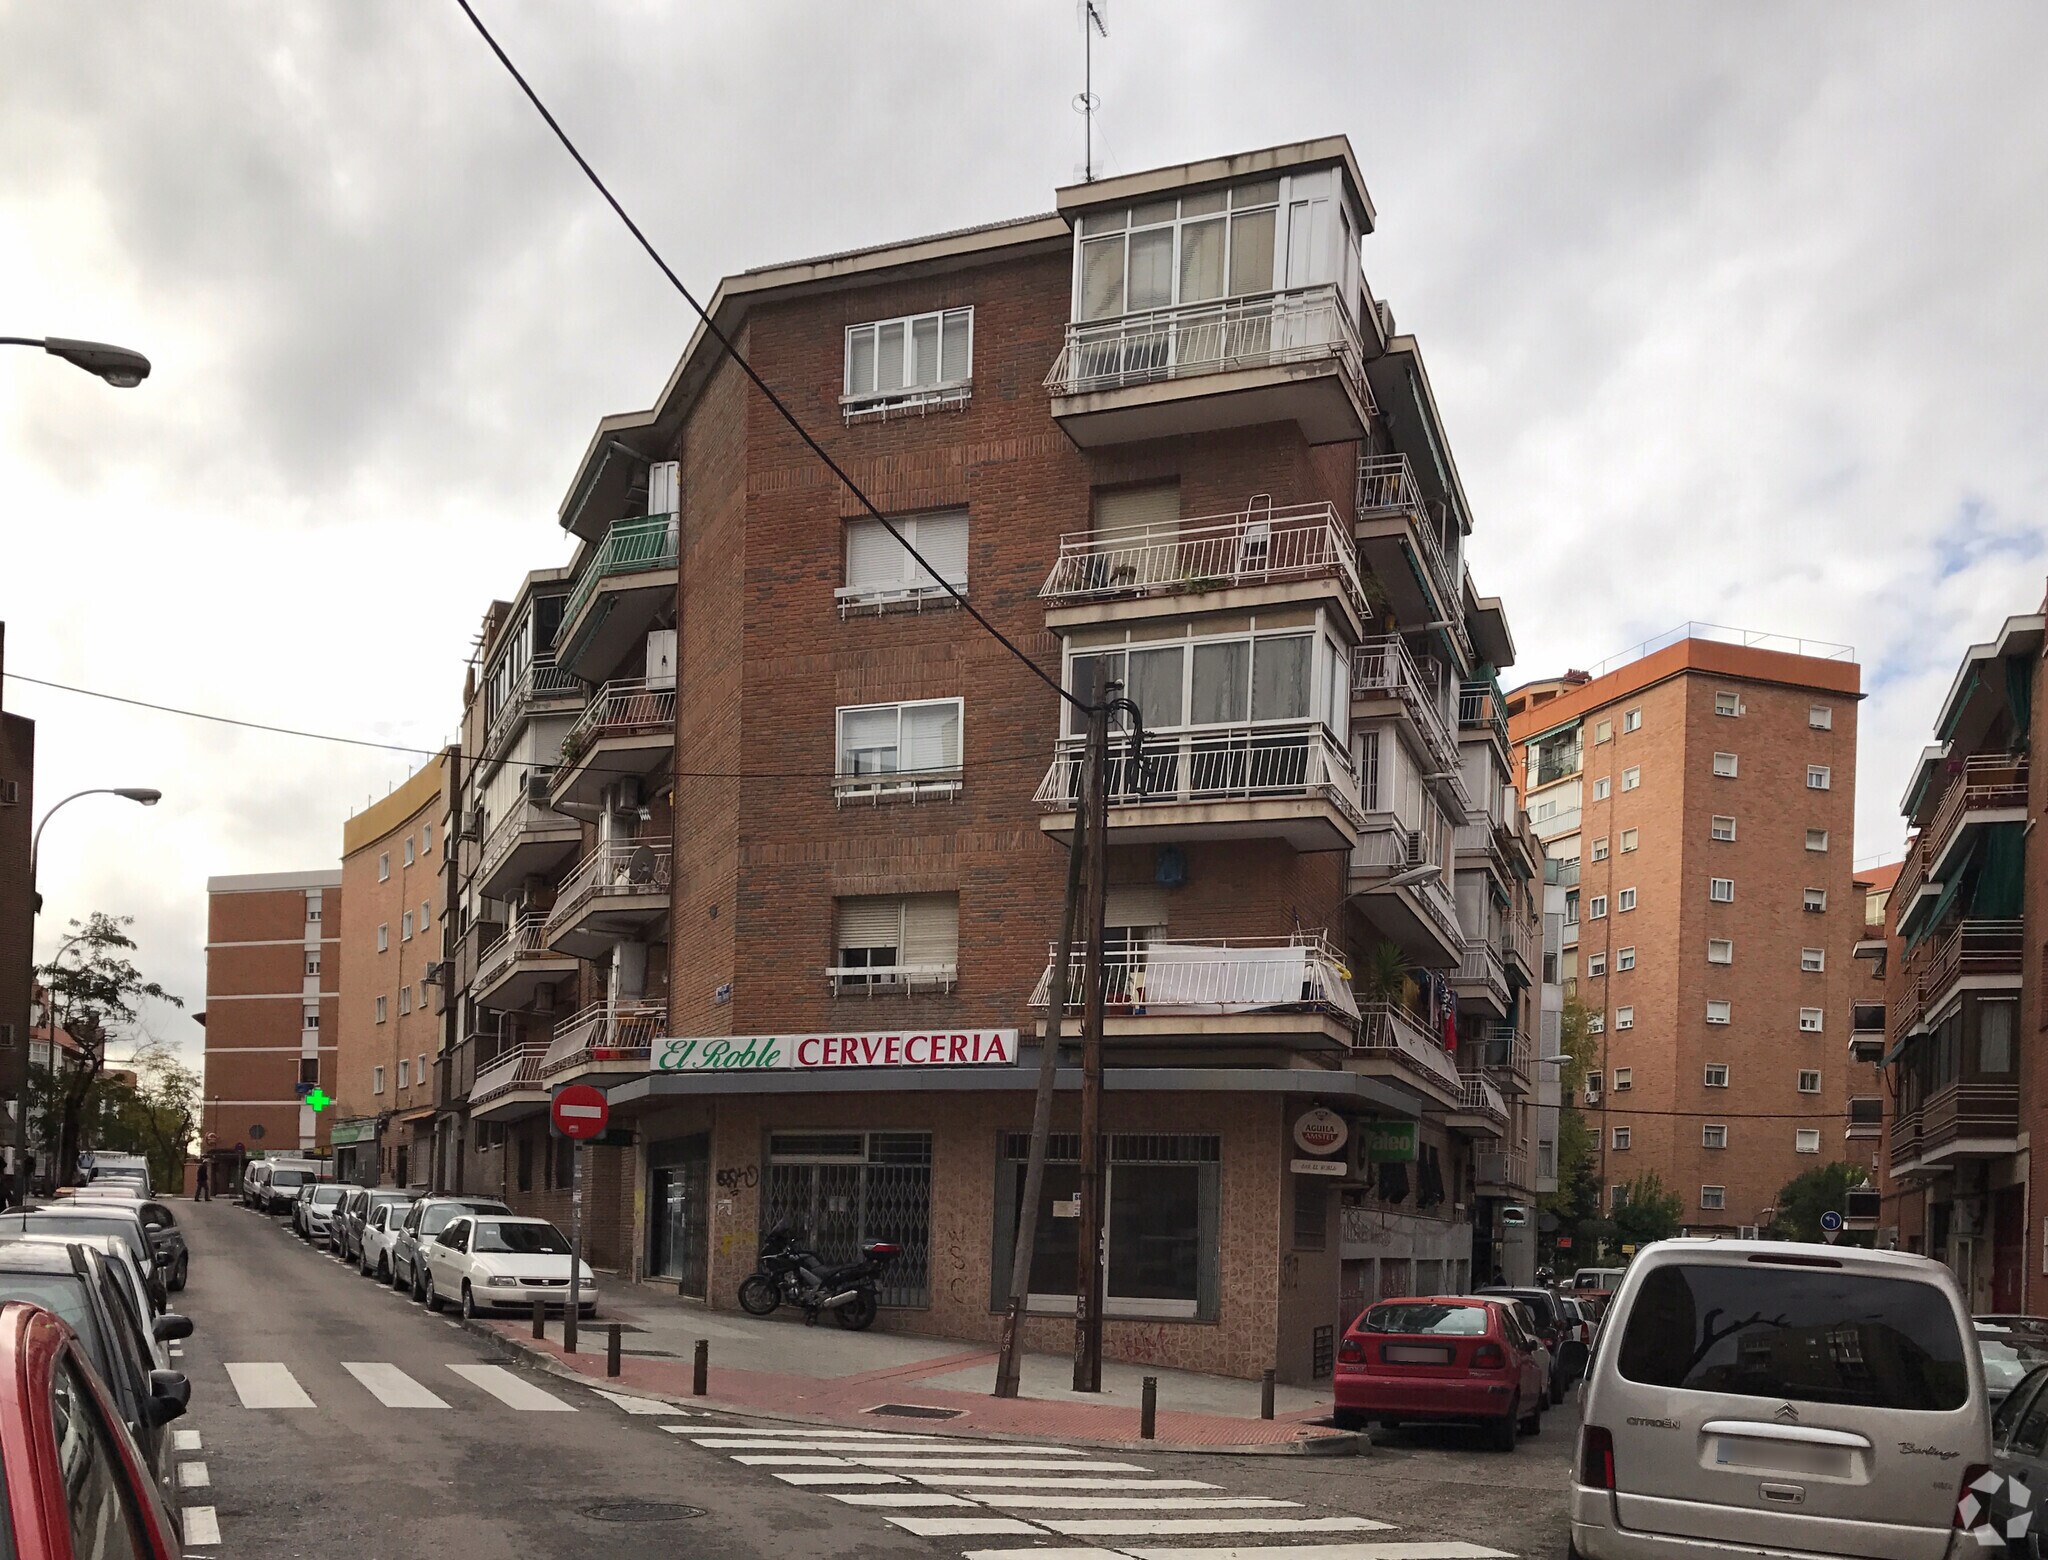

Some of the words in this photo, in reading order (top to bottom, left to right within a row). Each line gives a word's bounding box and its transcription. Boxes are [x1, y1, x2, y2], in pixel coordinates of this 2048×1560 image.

[658, 1039, 697, 1069] El
[692, 1038, 781, 1069] Roble
[799, 1034, 1007, 1065] CERVECERIA
[1305, 1124, 1335, 1133] AGUILA
[1626, 1417, 1681, 1430] CITROËN
[1897, 1442, 1960, 1460] Berlingo
